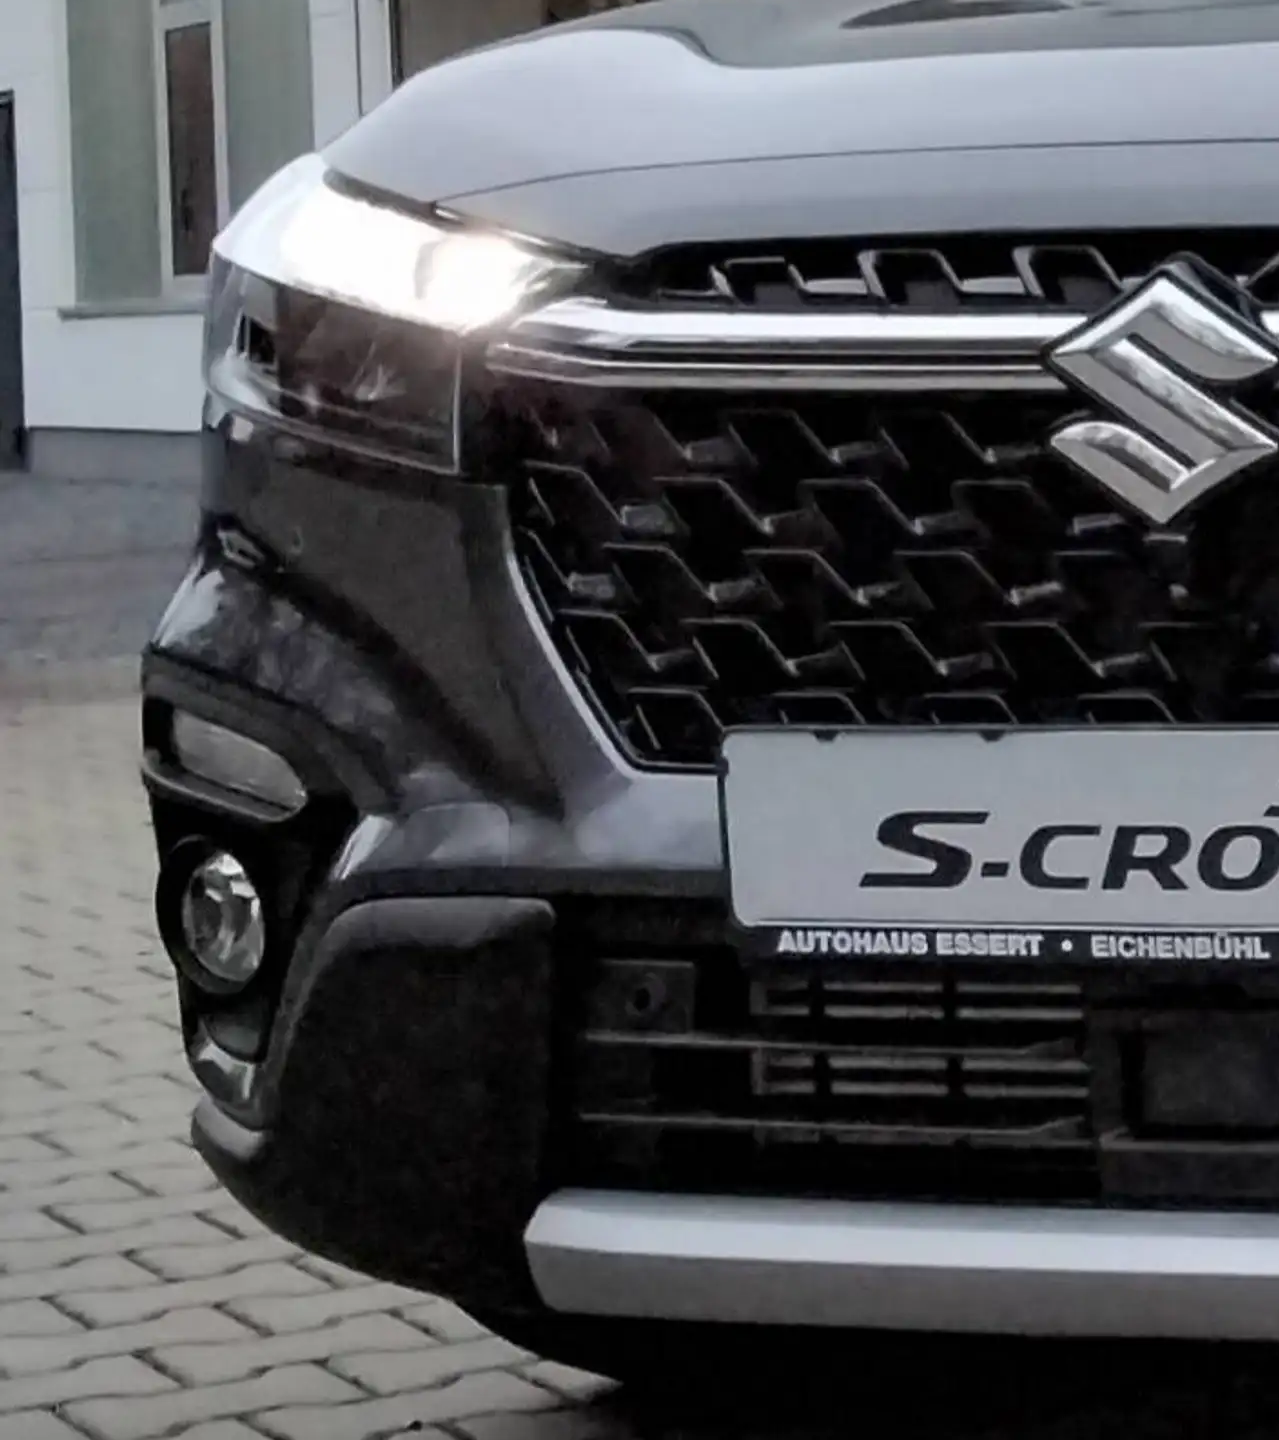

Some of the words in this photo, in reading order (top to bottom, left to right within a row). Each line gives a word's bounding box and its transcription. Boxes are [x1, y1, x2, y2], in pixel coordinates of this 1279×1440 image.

[776, 931, 929, 955] AUTOHAUS
[935, 933, 1045, 957] ESSERT
[1090, 930, 1271, 960] EICHENBÜHL
